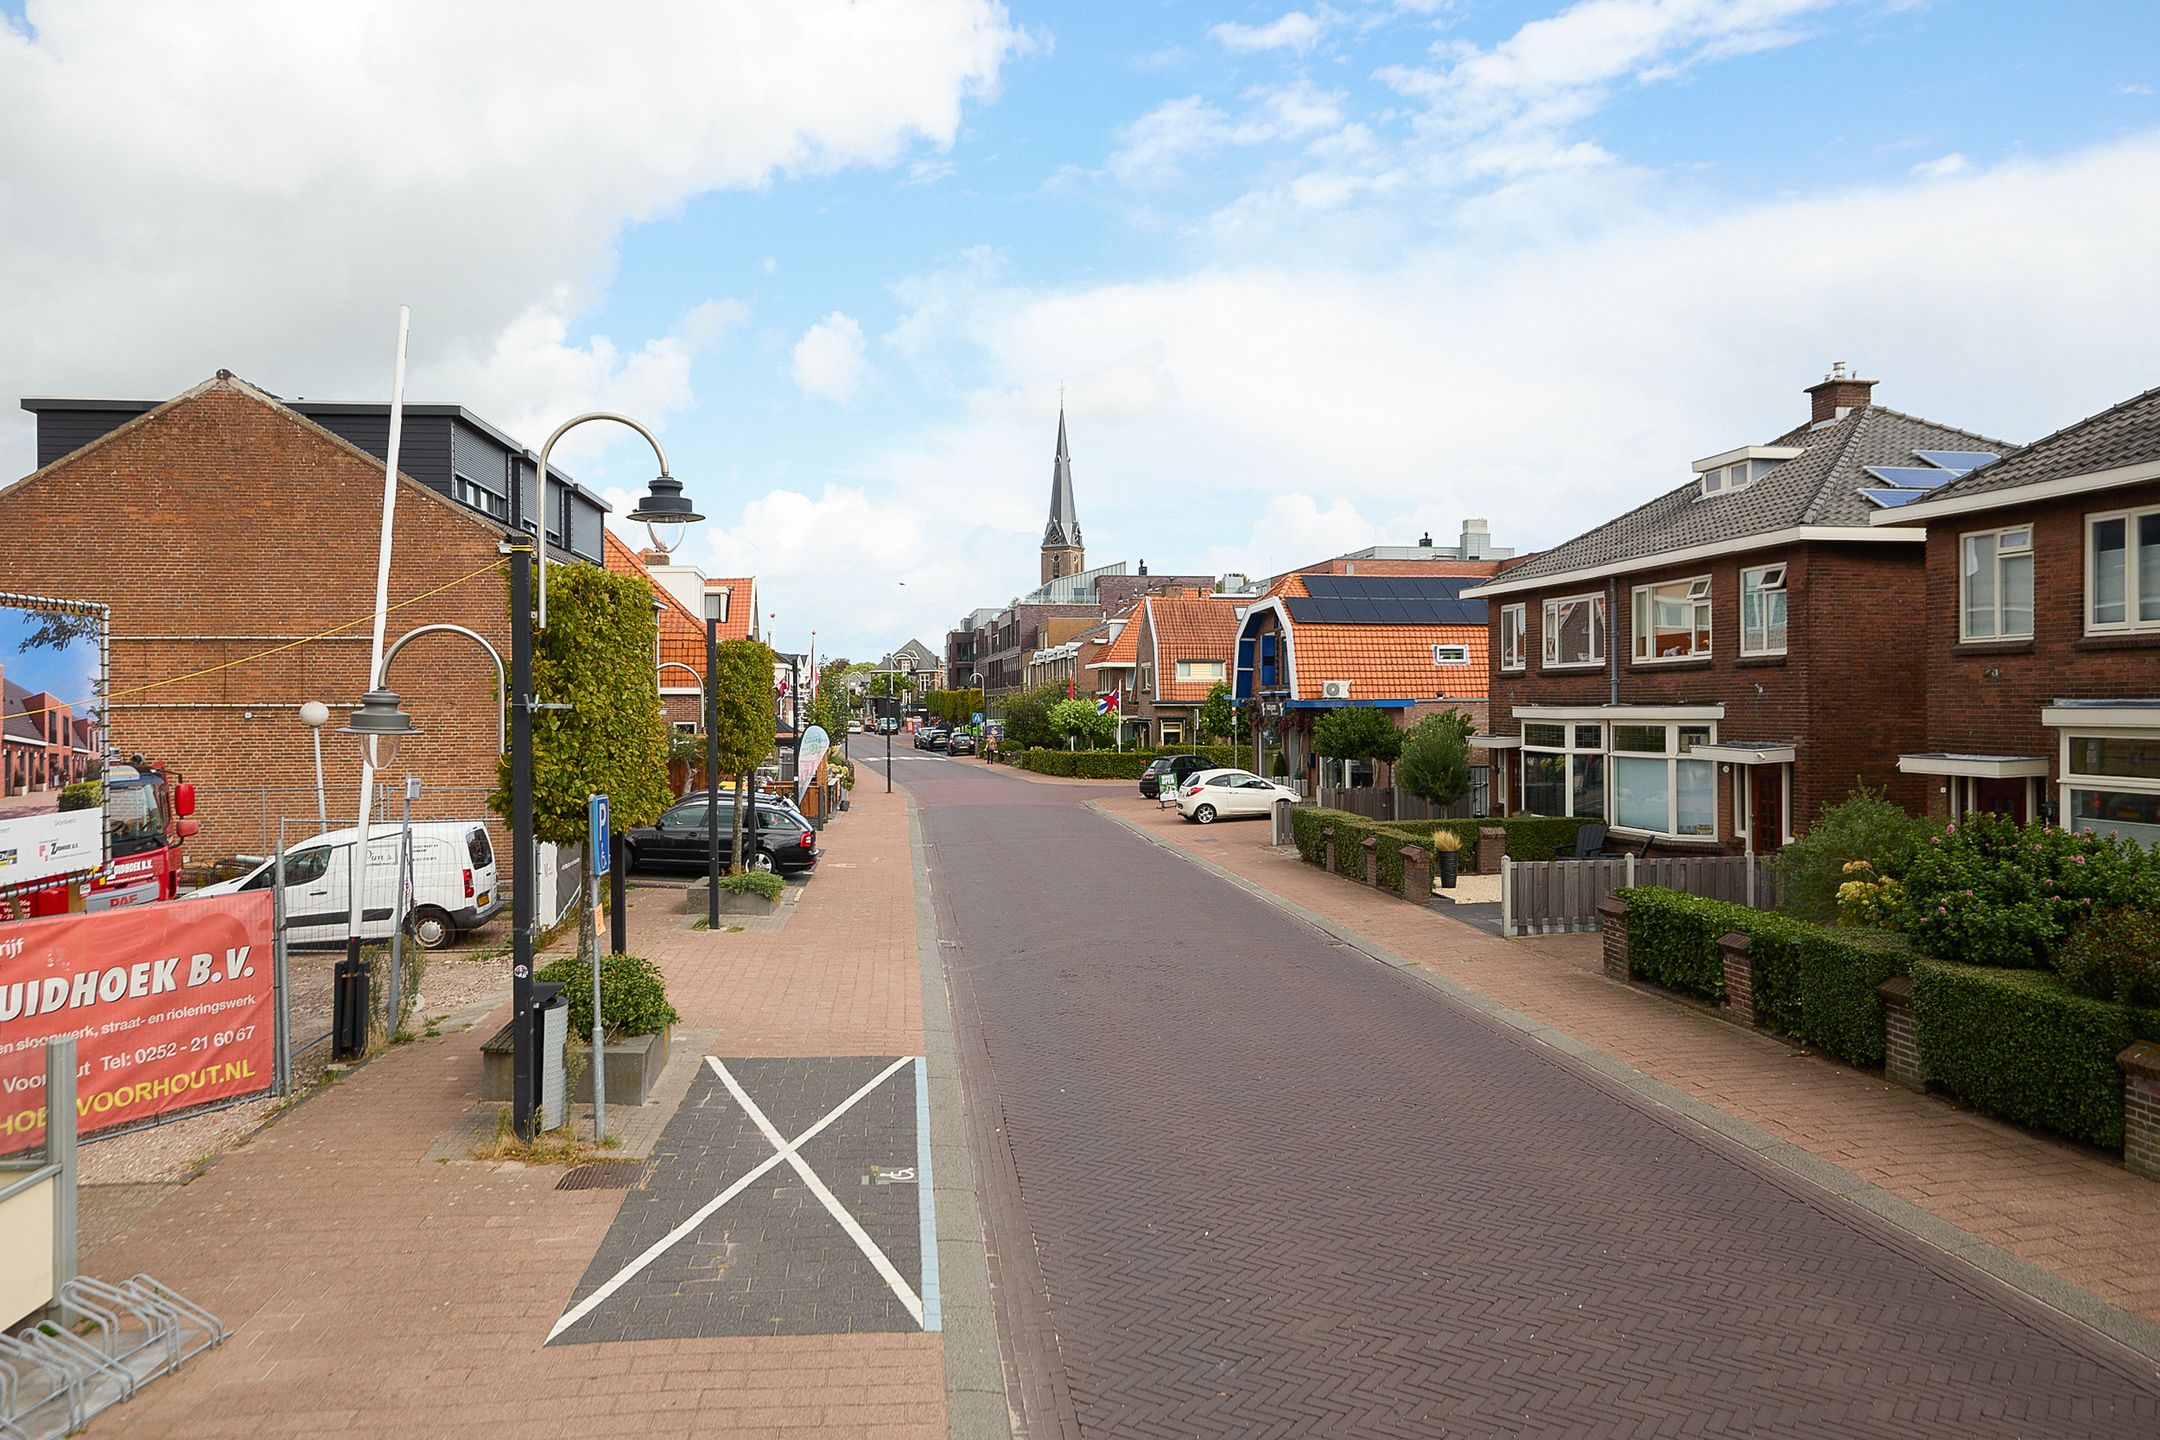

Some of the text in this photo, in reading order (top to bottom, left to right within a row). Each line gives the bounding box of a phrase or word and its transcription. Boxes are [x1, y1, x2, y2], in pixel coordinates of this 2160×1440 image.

[598, 802, 607, 841] P
[110, 894, 138, 908] DAF
[0, 945, 255, 1022] UIDHOEK B.V.
[101, 1016, 145, 1035] straat-
[148, 1012, 164, 1025] en
[166, 993, 256, 1020] rioleringswerk
[100, 1052, 131, 1071] Tel:
[135, 1042, 177, 1064] 0252
[190, 1034, 208, 1052] 21
[213, 1030, 234, 1048] 60
[235, 1025, 256, 1041] 67
[0, 1058, 256, 1137] HOEVOORHOUT.NL
